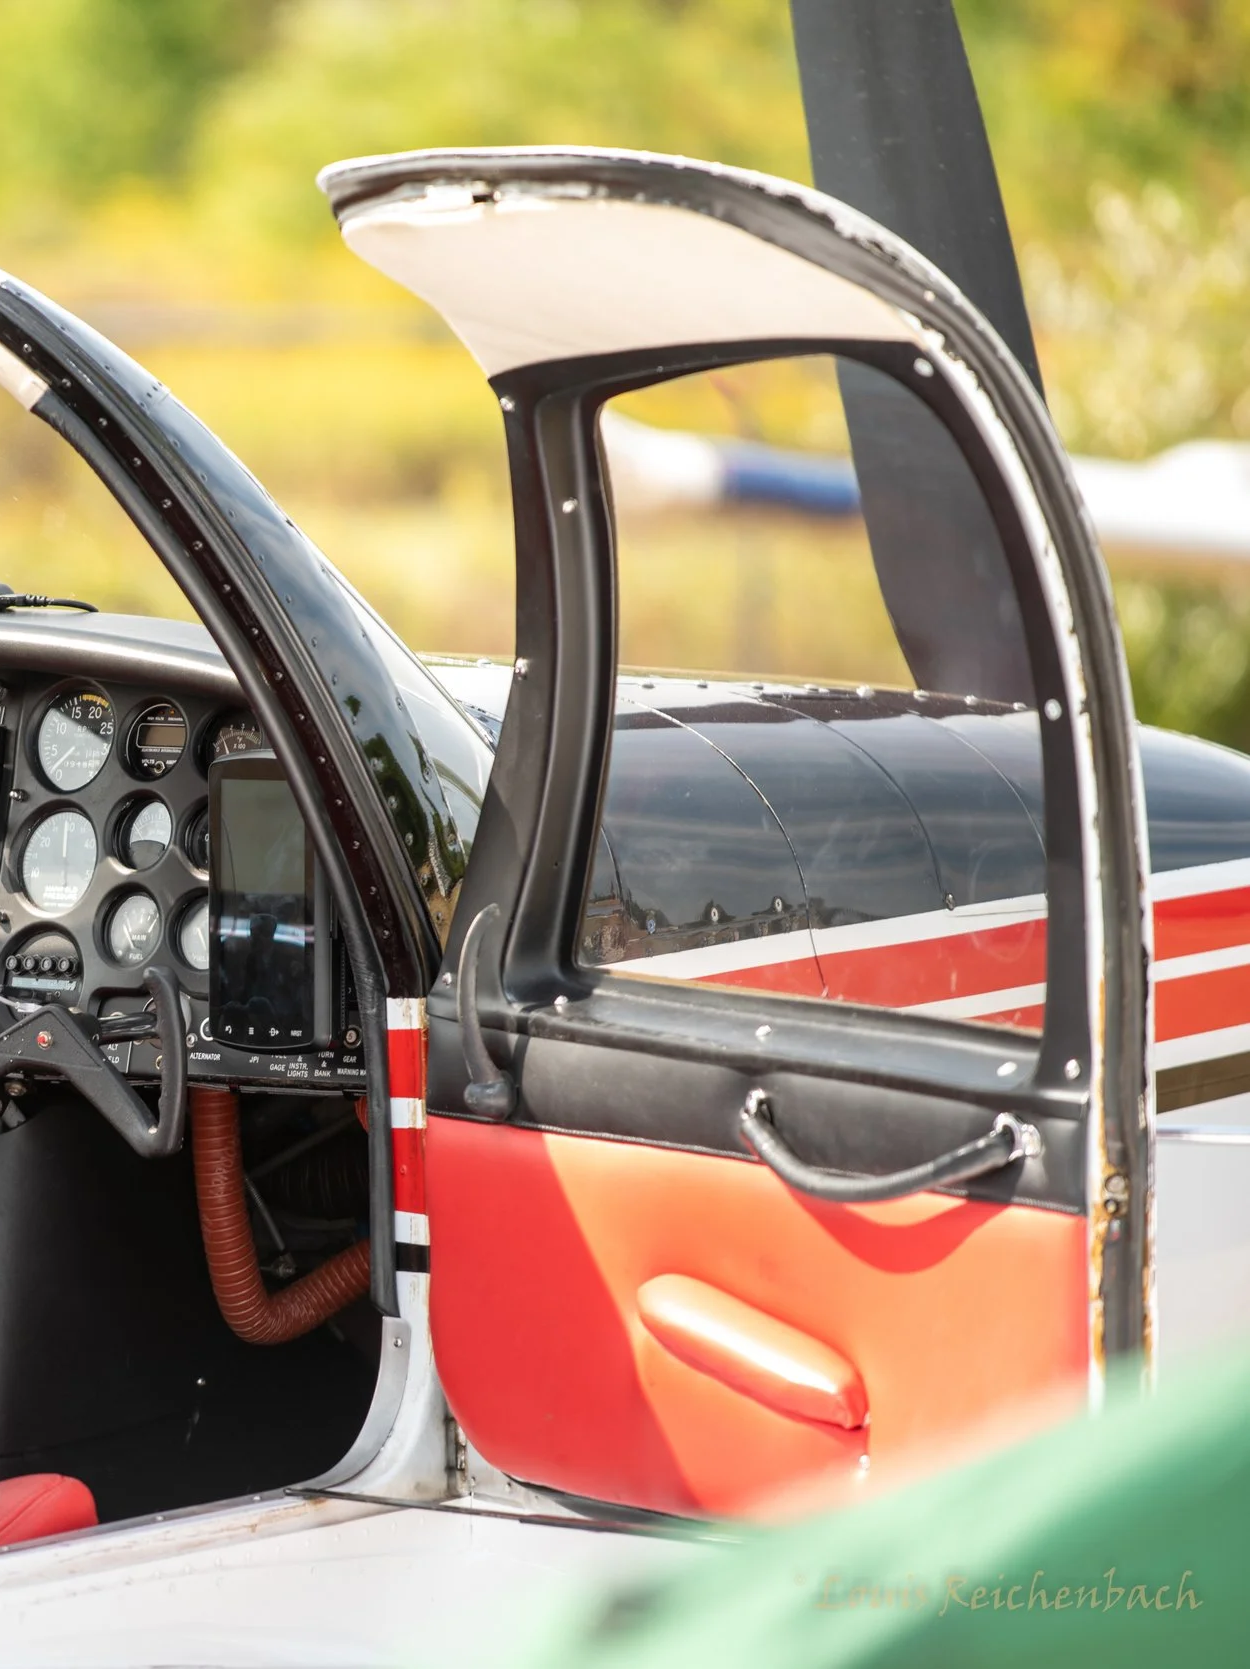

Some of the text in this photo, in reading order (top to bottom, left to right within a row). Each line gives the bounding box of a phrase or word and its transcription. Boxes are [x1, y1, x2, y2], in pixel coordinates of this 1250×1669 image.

[72, 706, 82, 719] 15
[88, 706, 102, 719] 20
[56, 722, 66, 735] 10
[100, 722, 114, 735] 25
[52, 744, 58, 756] 5
[56, 768, 62, 781] 0
[40, 837, 50, 848] 20
[31, 866, 40, 878] 10
[129, 952, 144, 960] FUEL
[290, 1029, 302, 1037] NRST
[190, 1052, 221, 1060] ALTERNATOR
[270, 1064, 286, 1072] GAGE
[337, 1068, 359, 1076] WARNING
[287, 1070, 308, 1078] LIGHTS
[314, 1070, 331, 1078] BANK
